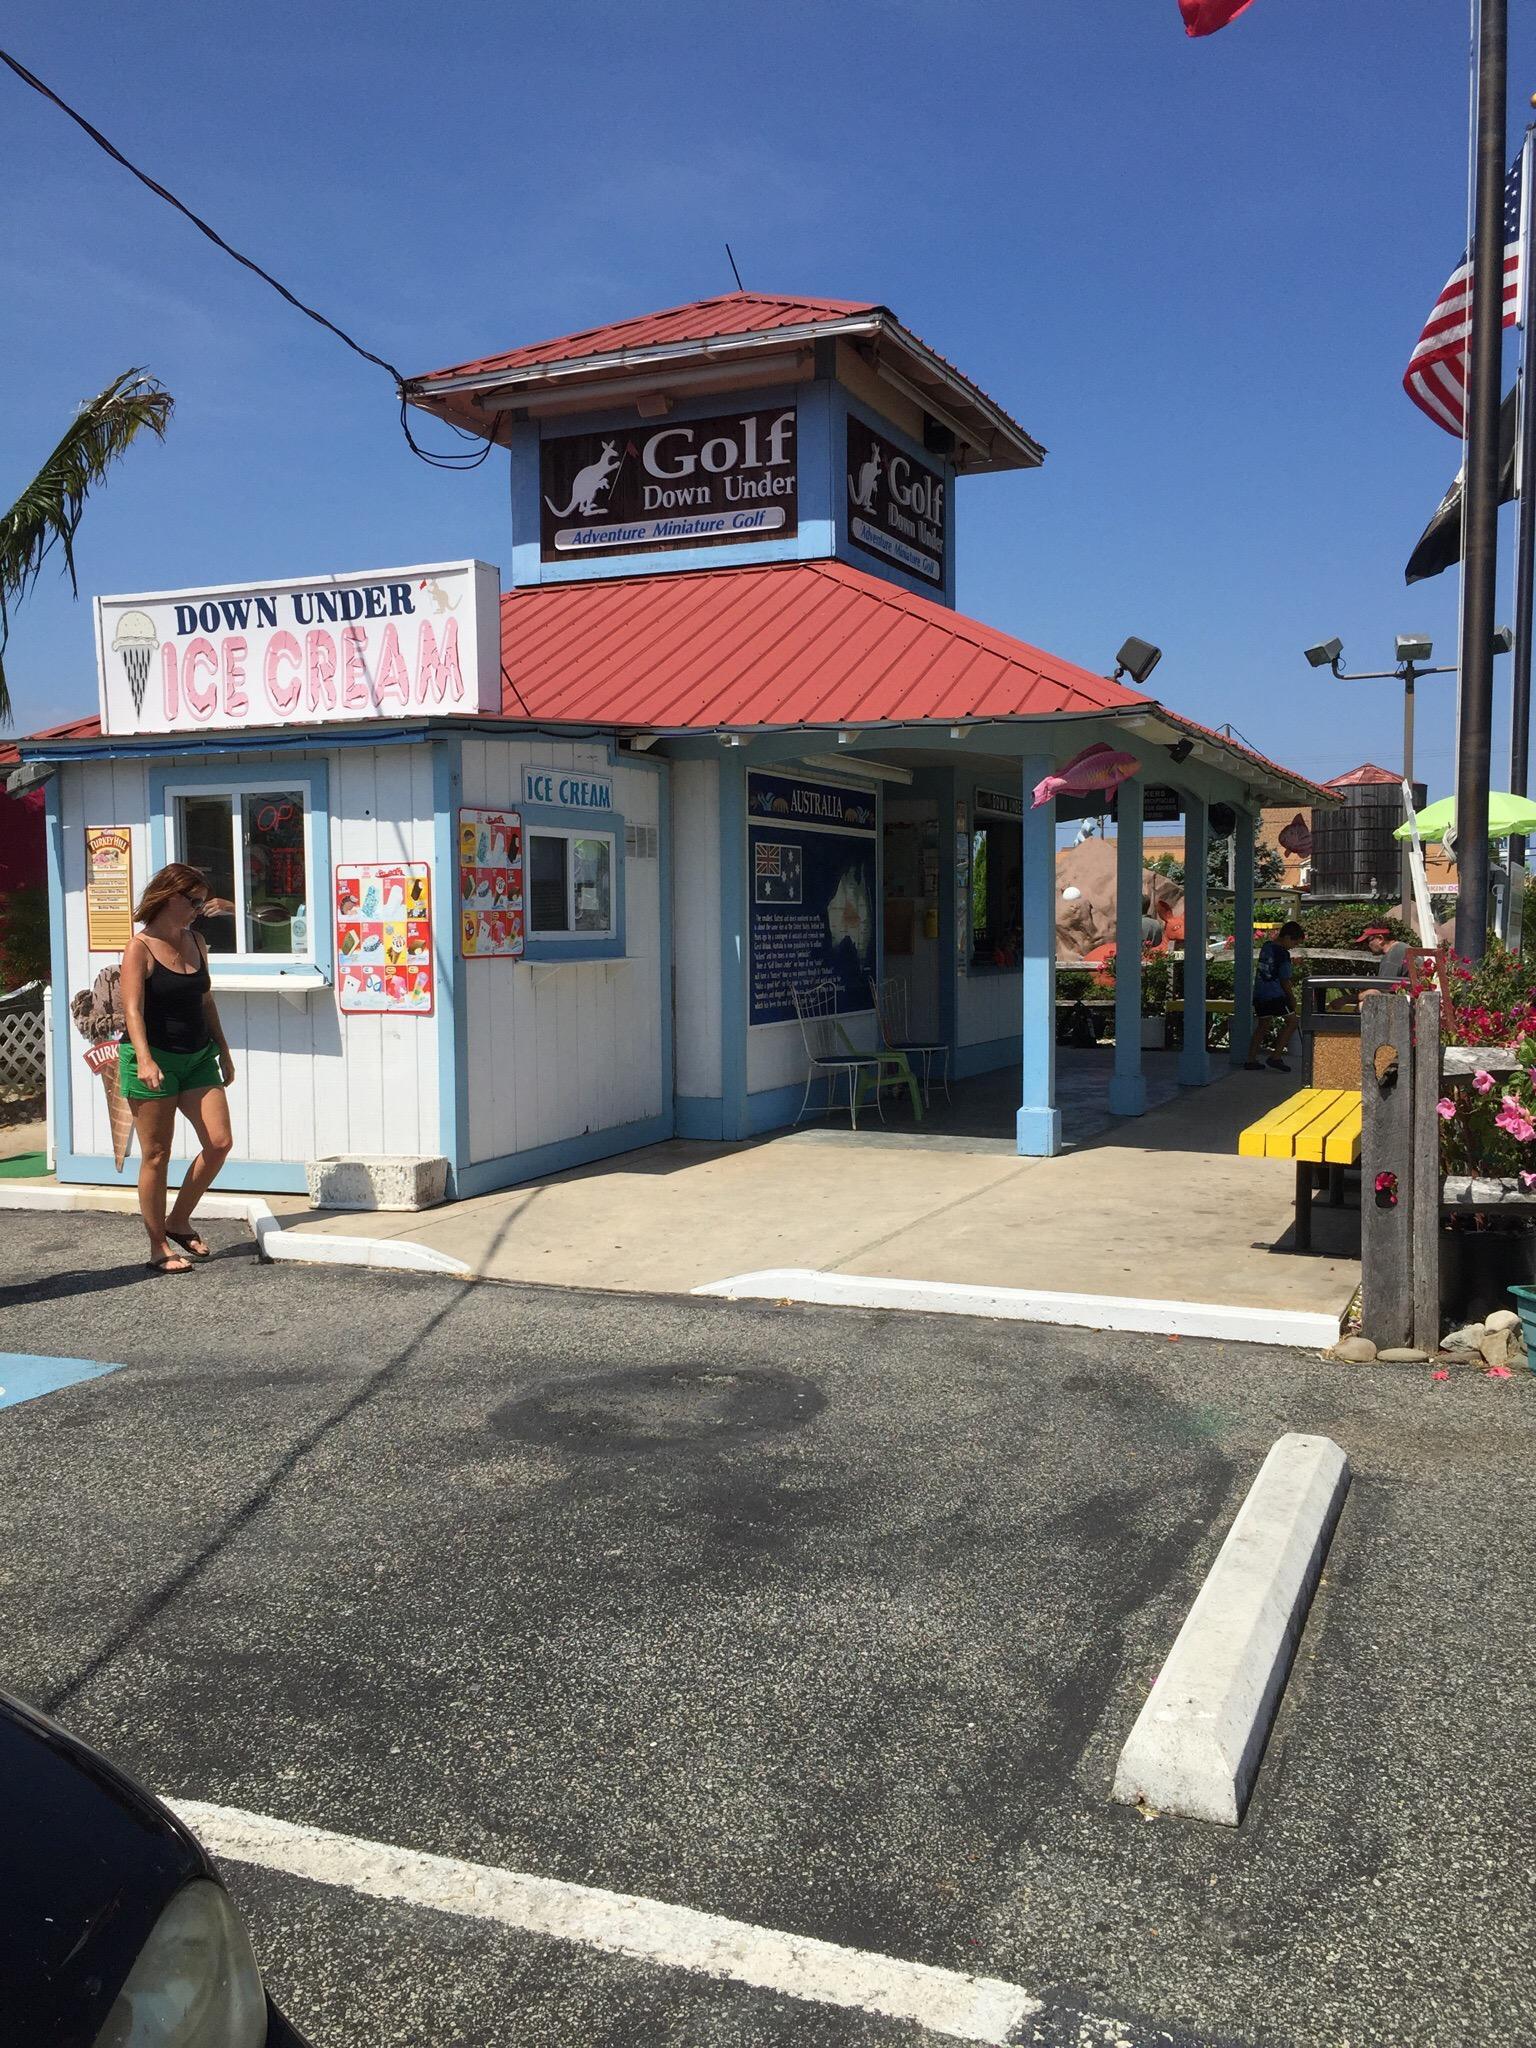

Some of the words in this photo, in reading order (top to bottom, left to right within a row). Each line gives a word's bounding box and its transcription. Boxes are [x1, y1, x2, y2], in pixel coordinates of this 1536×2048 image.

[642, 411, 795, 479] Golf
[643, 485, 712, 511] Down
[723, 471, 796, 501] Under
[888, 456, 944, 527] Golf
[571, 527, 645, 545] Adventure
[653, 516, 724, 537] Miniature
[732, 511, 766, 529] Golf
[860, 524, 893, 552] Adventure
[895, 542, 921, 568] Miniature
[922, 557, 935, 573] Golf
[888, 502, 916, 538] Down
[918, 520, 944, 554] Under
[174, 596, 278, 636] DOWN
[291, 582, 416, 625] UNDER
[161, 635, 249, 722] ICE
[264, 616, 465, 717] CREAM
[527, 775, 553, 802] ICE
[559, 779, 611, 808] CREAM
[790, 789, 843, 818] AUSTRALIA
[90, 836, 114, 851] TURKEY
[87, 1043, 119, 1066] TURK
